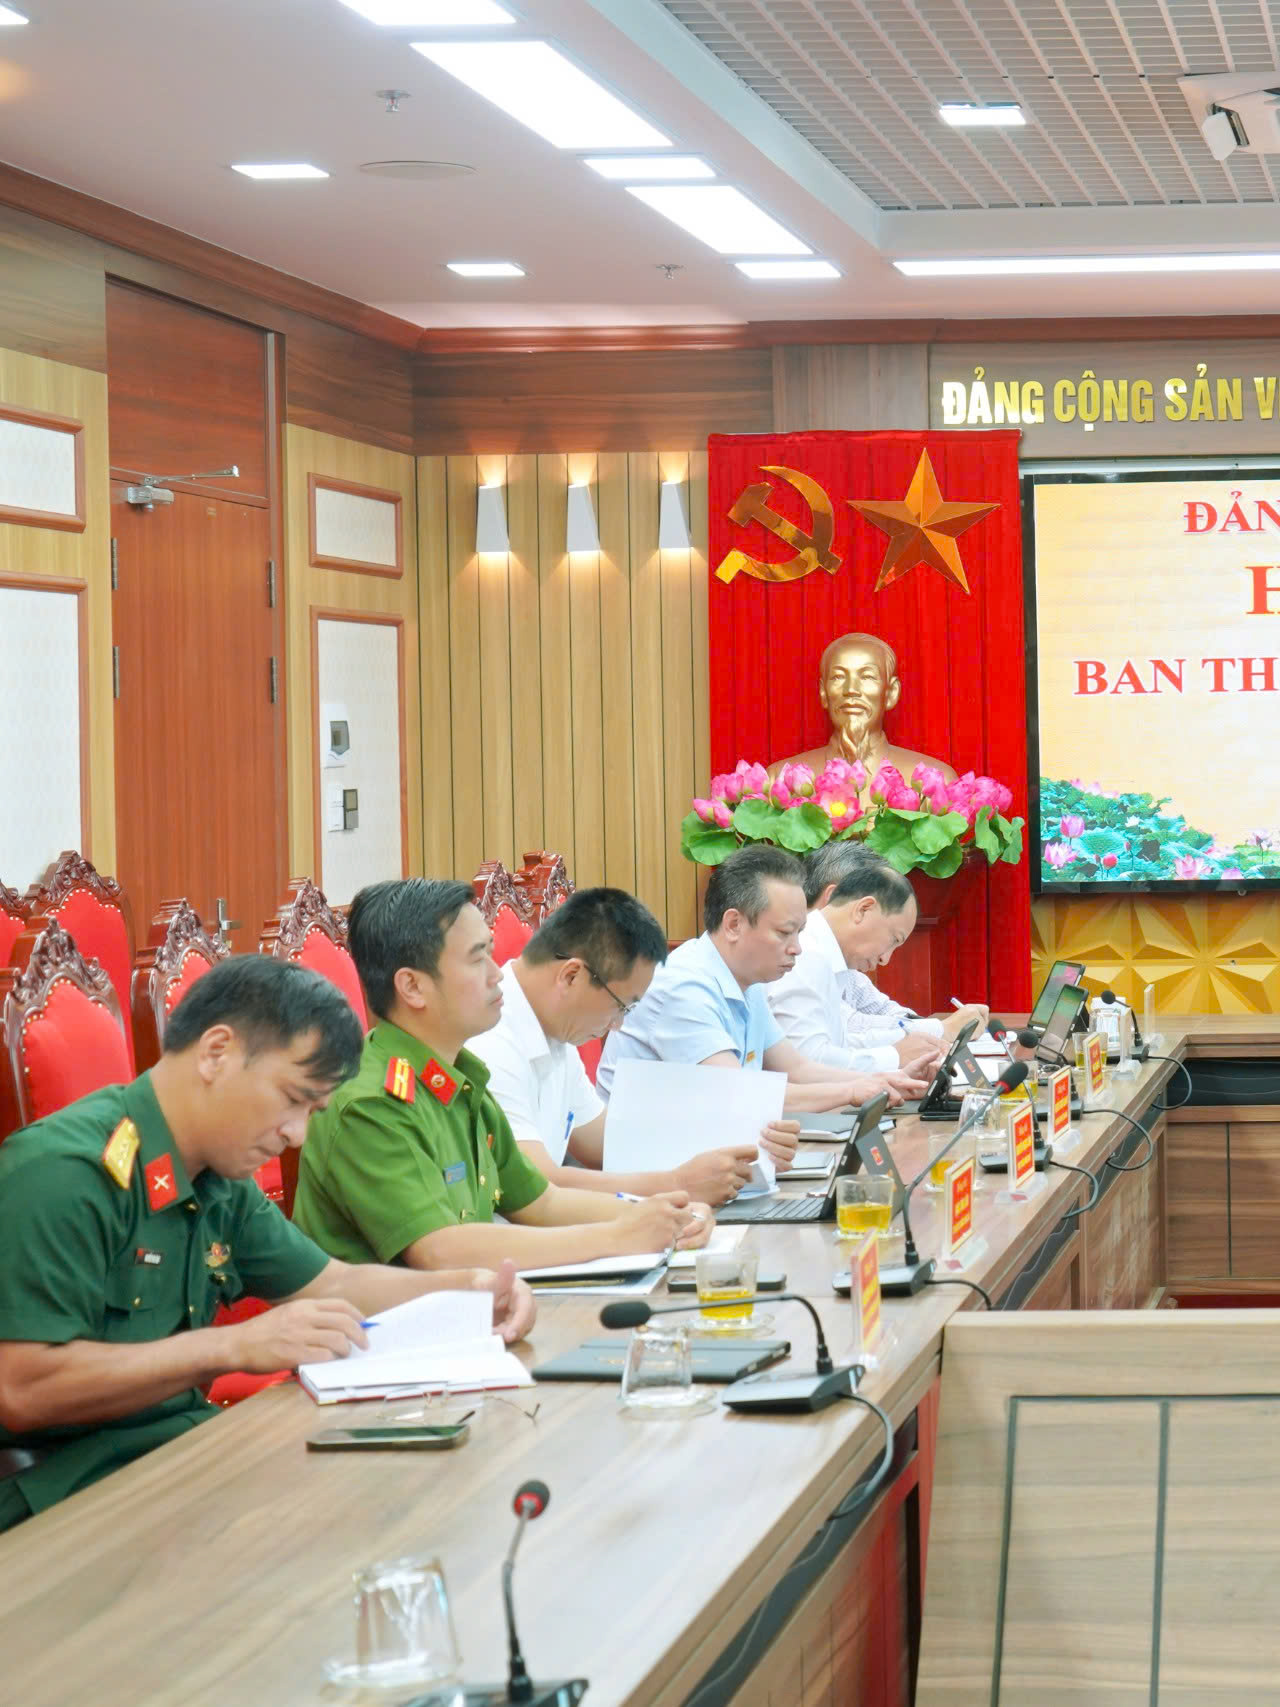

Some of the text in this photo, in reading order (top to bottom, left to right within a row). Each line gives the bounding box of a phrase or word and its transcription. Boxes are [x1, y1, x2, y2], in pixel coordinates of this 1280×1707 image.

[942, 367, 1045, 425] ĐẢNG
[1053, 370, 1154, 431] CỘNG
[1165, 363, 1244, 422] SẢN
[1073, 658, 1186, 695] BAN
